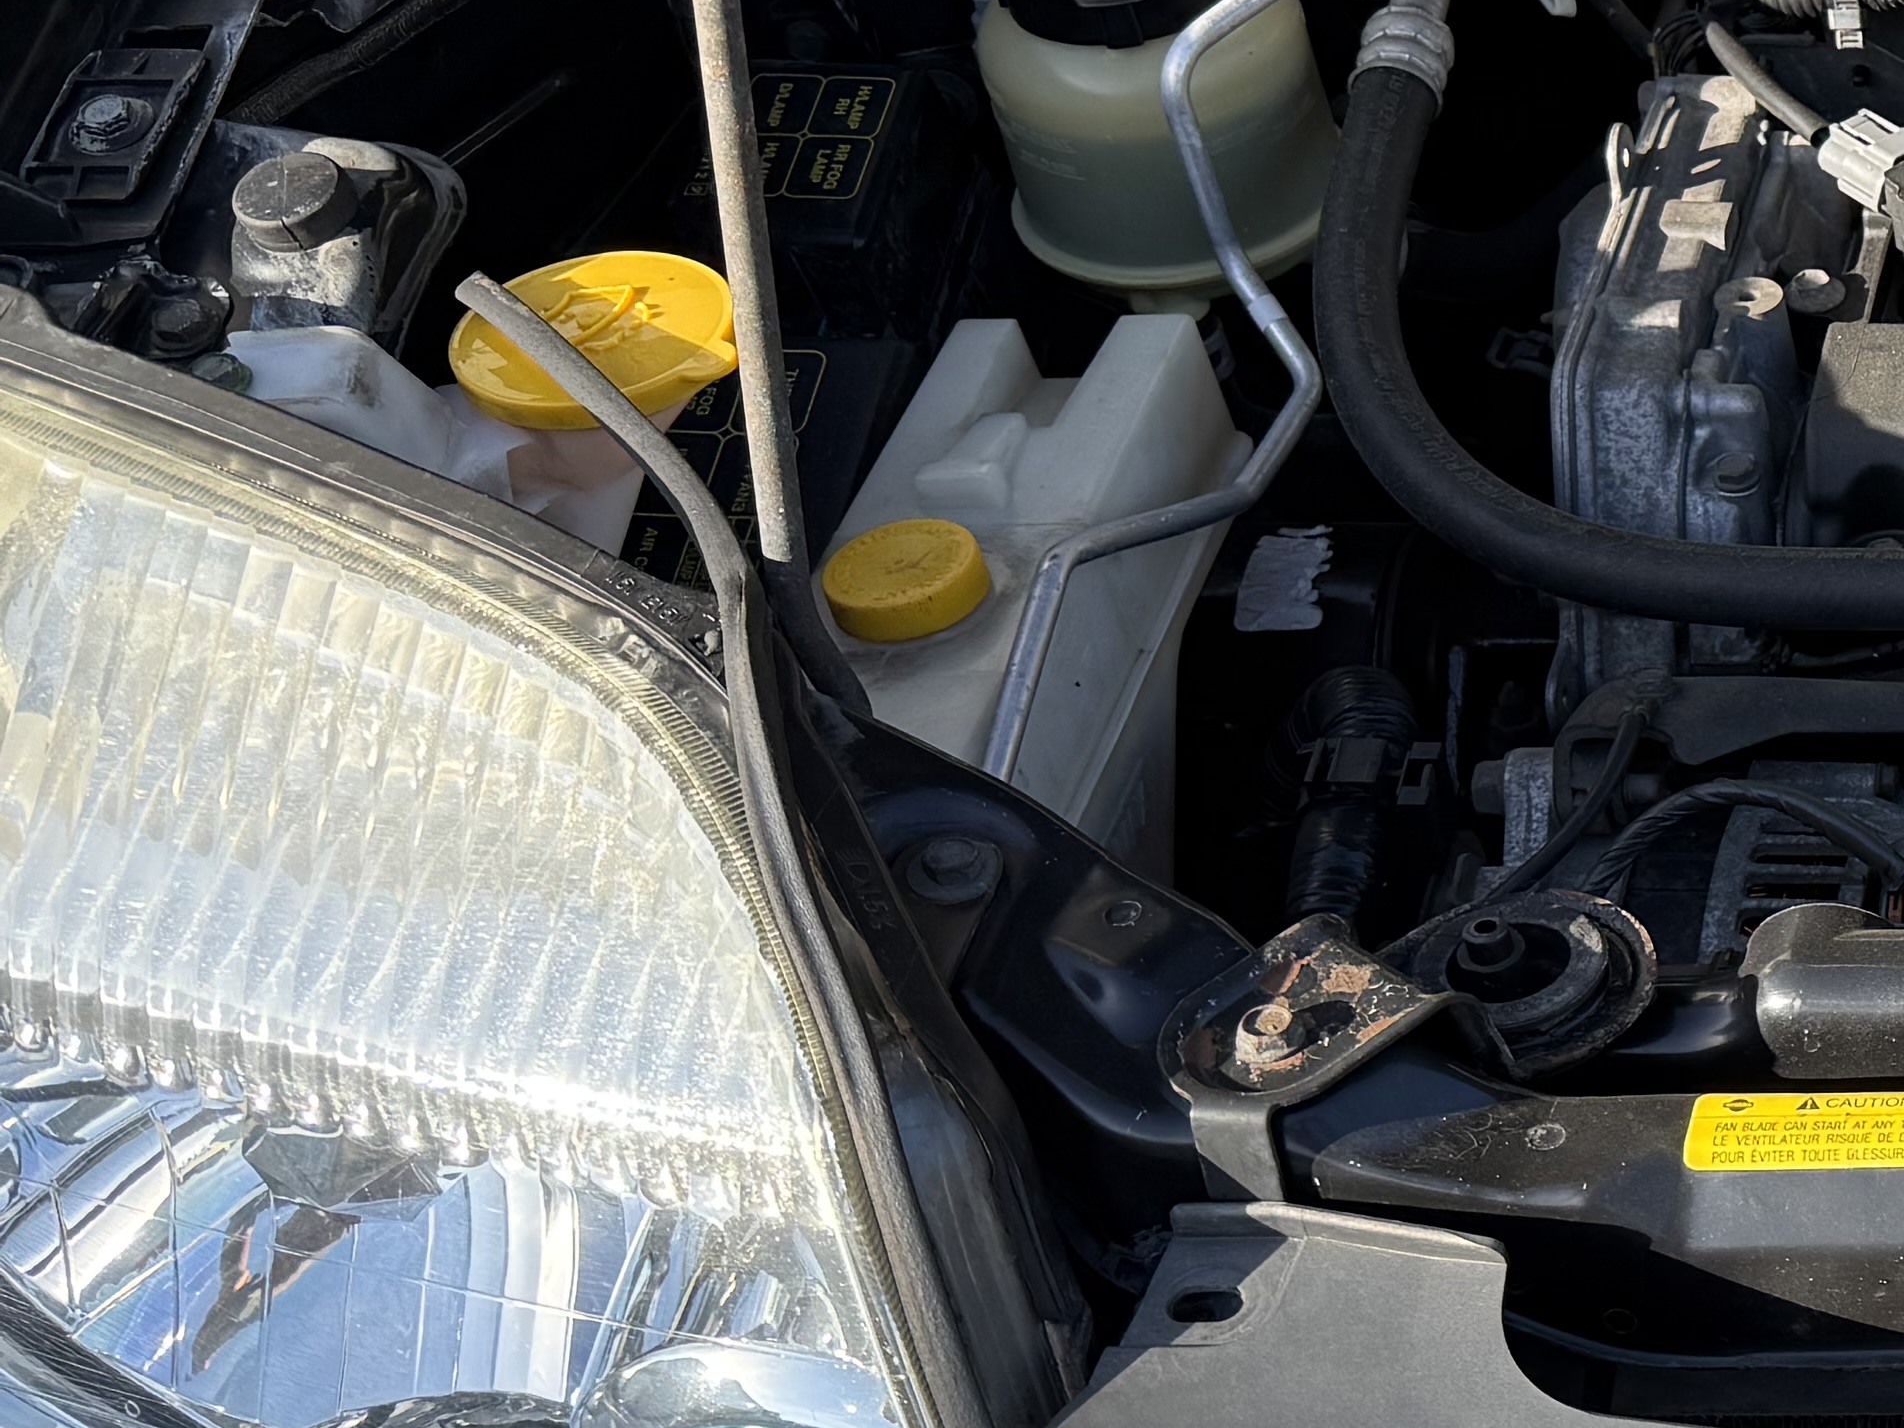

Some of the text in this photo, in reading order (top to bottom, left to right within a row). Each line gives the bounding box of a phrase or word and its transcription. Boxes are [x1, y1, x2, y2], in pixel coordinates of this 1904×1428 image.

[833, 98, 851, 115] RH
[809, 149, 833, 184] LAMP
[823, 165, 846, 190] FOG
[639, 527, 659, 552] AIR
[1714, 1122, 1737, 1133] FAN
[1741, 1121, 1778, 1132] BLADE
[1783, 1120, 1807, 1131] CAN
[1812, 1119, 1848, 1131] START
[1853, 1119, 1867, 1130] AT
[1871, 1119, 1896, 1130] ANY
[1712, 1134, 1729, 1147] LE
[1735, 1133, 1820, 1146] VENTILATEUR
[1825, 1132, 1871, 1145] RISQUE
[1877, 1131, 1894, 1143] DE
[1711, 1151, 1745, 1164] POUR
[1751, 1147, 1795, 1163] ÉVITER
[1801, 1150, 1841, 1162] TOUTE
